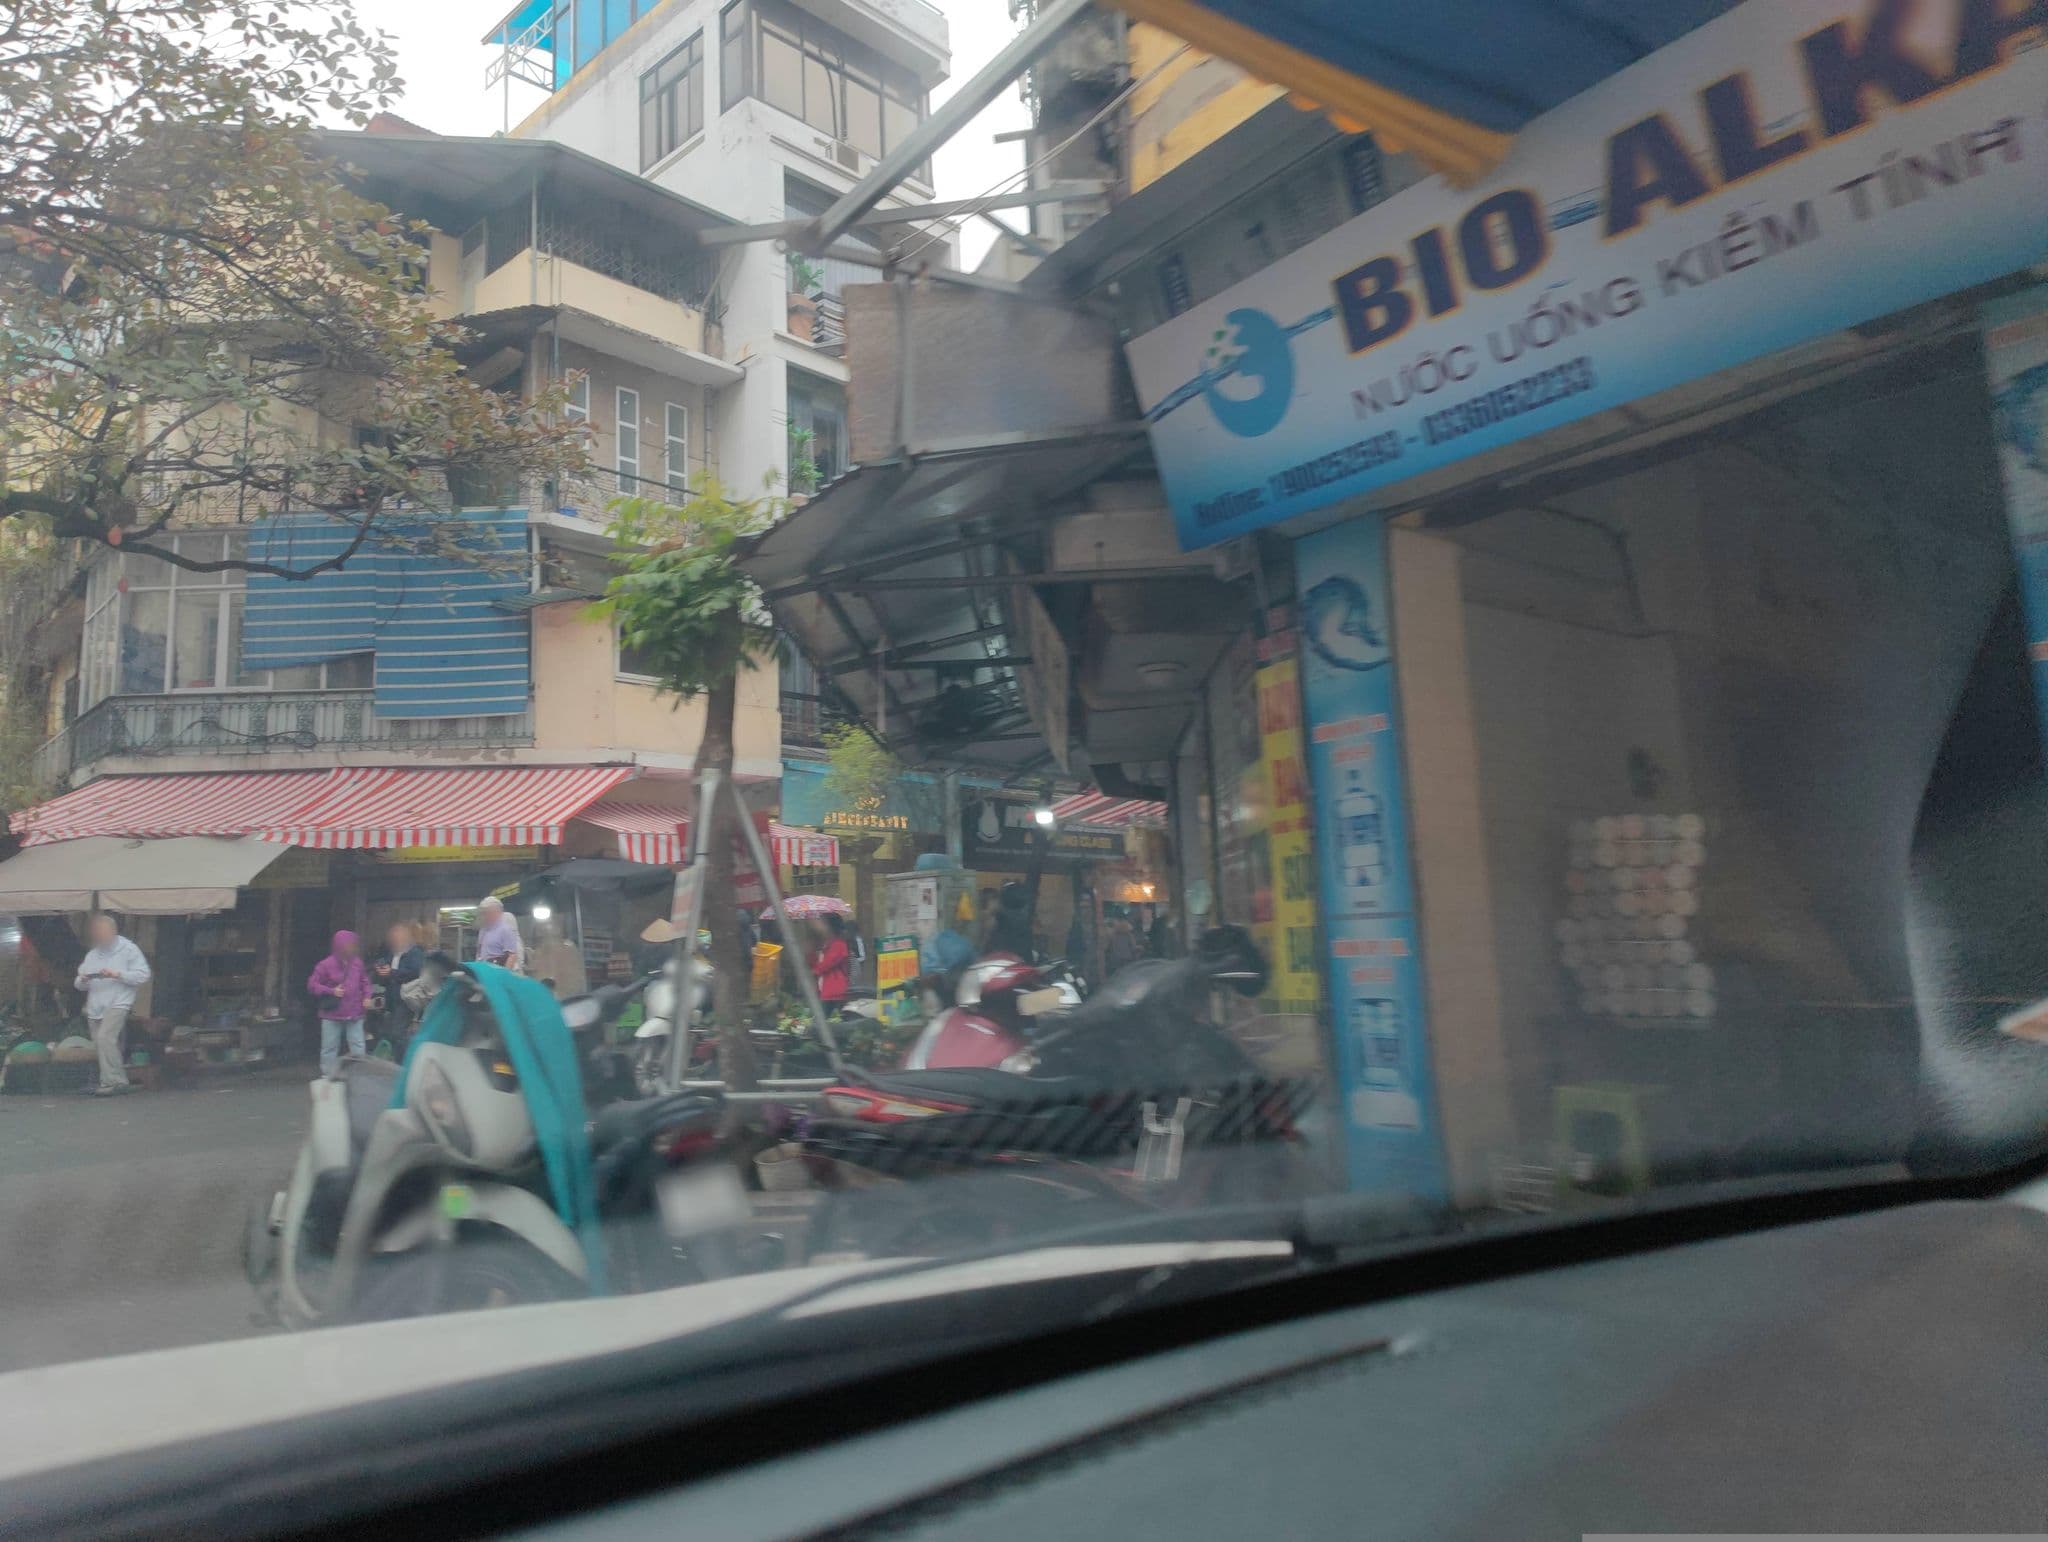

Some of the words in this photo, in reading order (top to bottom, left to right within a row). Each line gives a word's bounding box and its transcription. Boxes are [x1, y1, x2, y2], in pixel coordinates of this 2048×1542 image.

[1330, 187, 1551, 356] BIO
[1487, 277, 1646, 363] UỐNG
[1830, 117, 2024, 221] TÍNH
